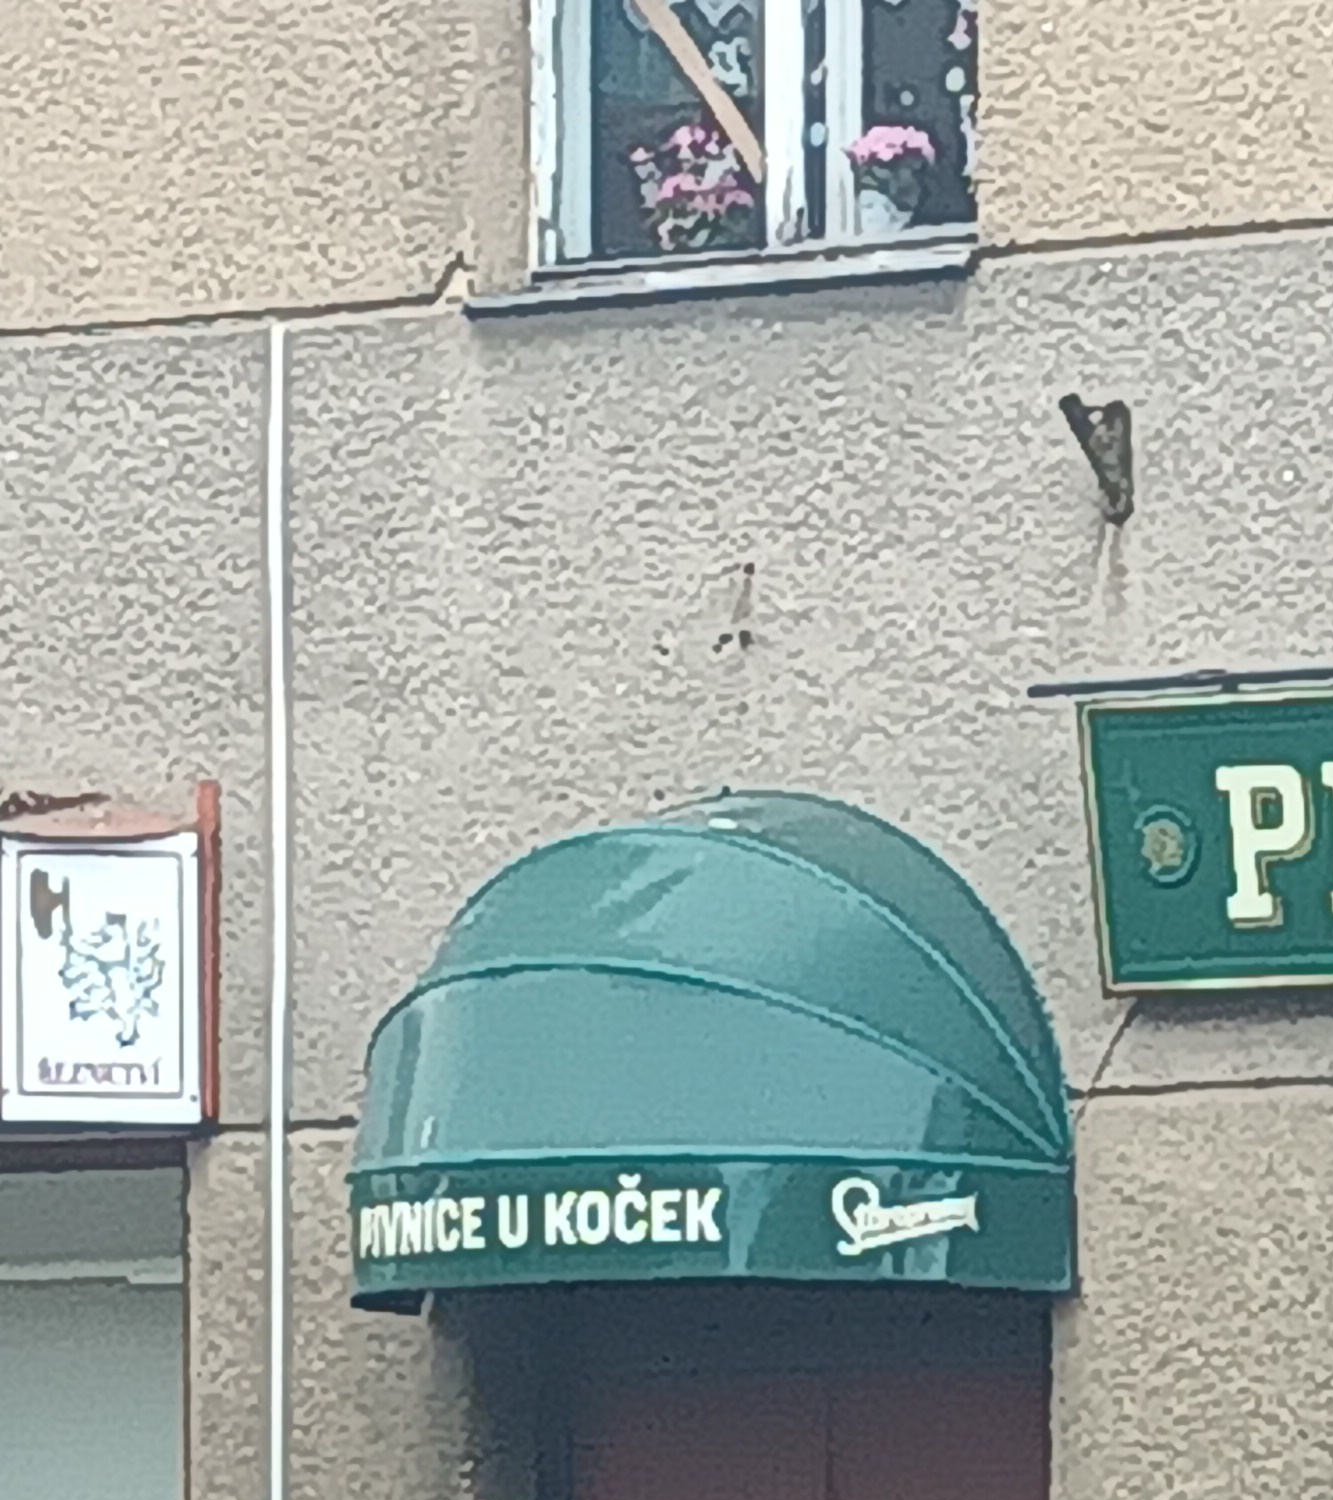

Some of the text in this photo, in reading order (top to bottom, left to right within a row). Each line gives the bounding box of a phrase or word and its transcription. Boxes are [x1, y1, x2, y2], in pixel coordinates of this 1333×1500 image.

[360, 1173, 722, 1259] PIVNICE U KOČEK
